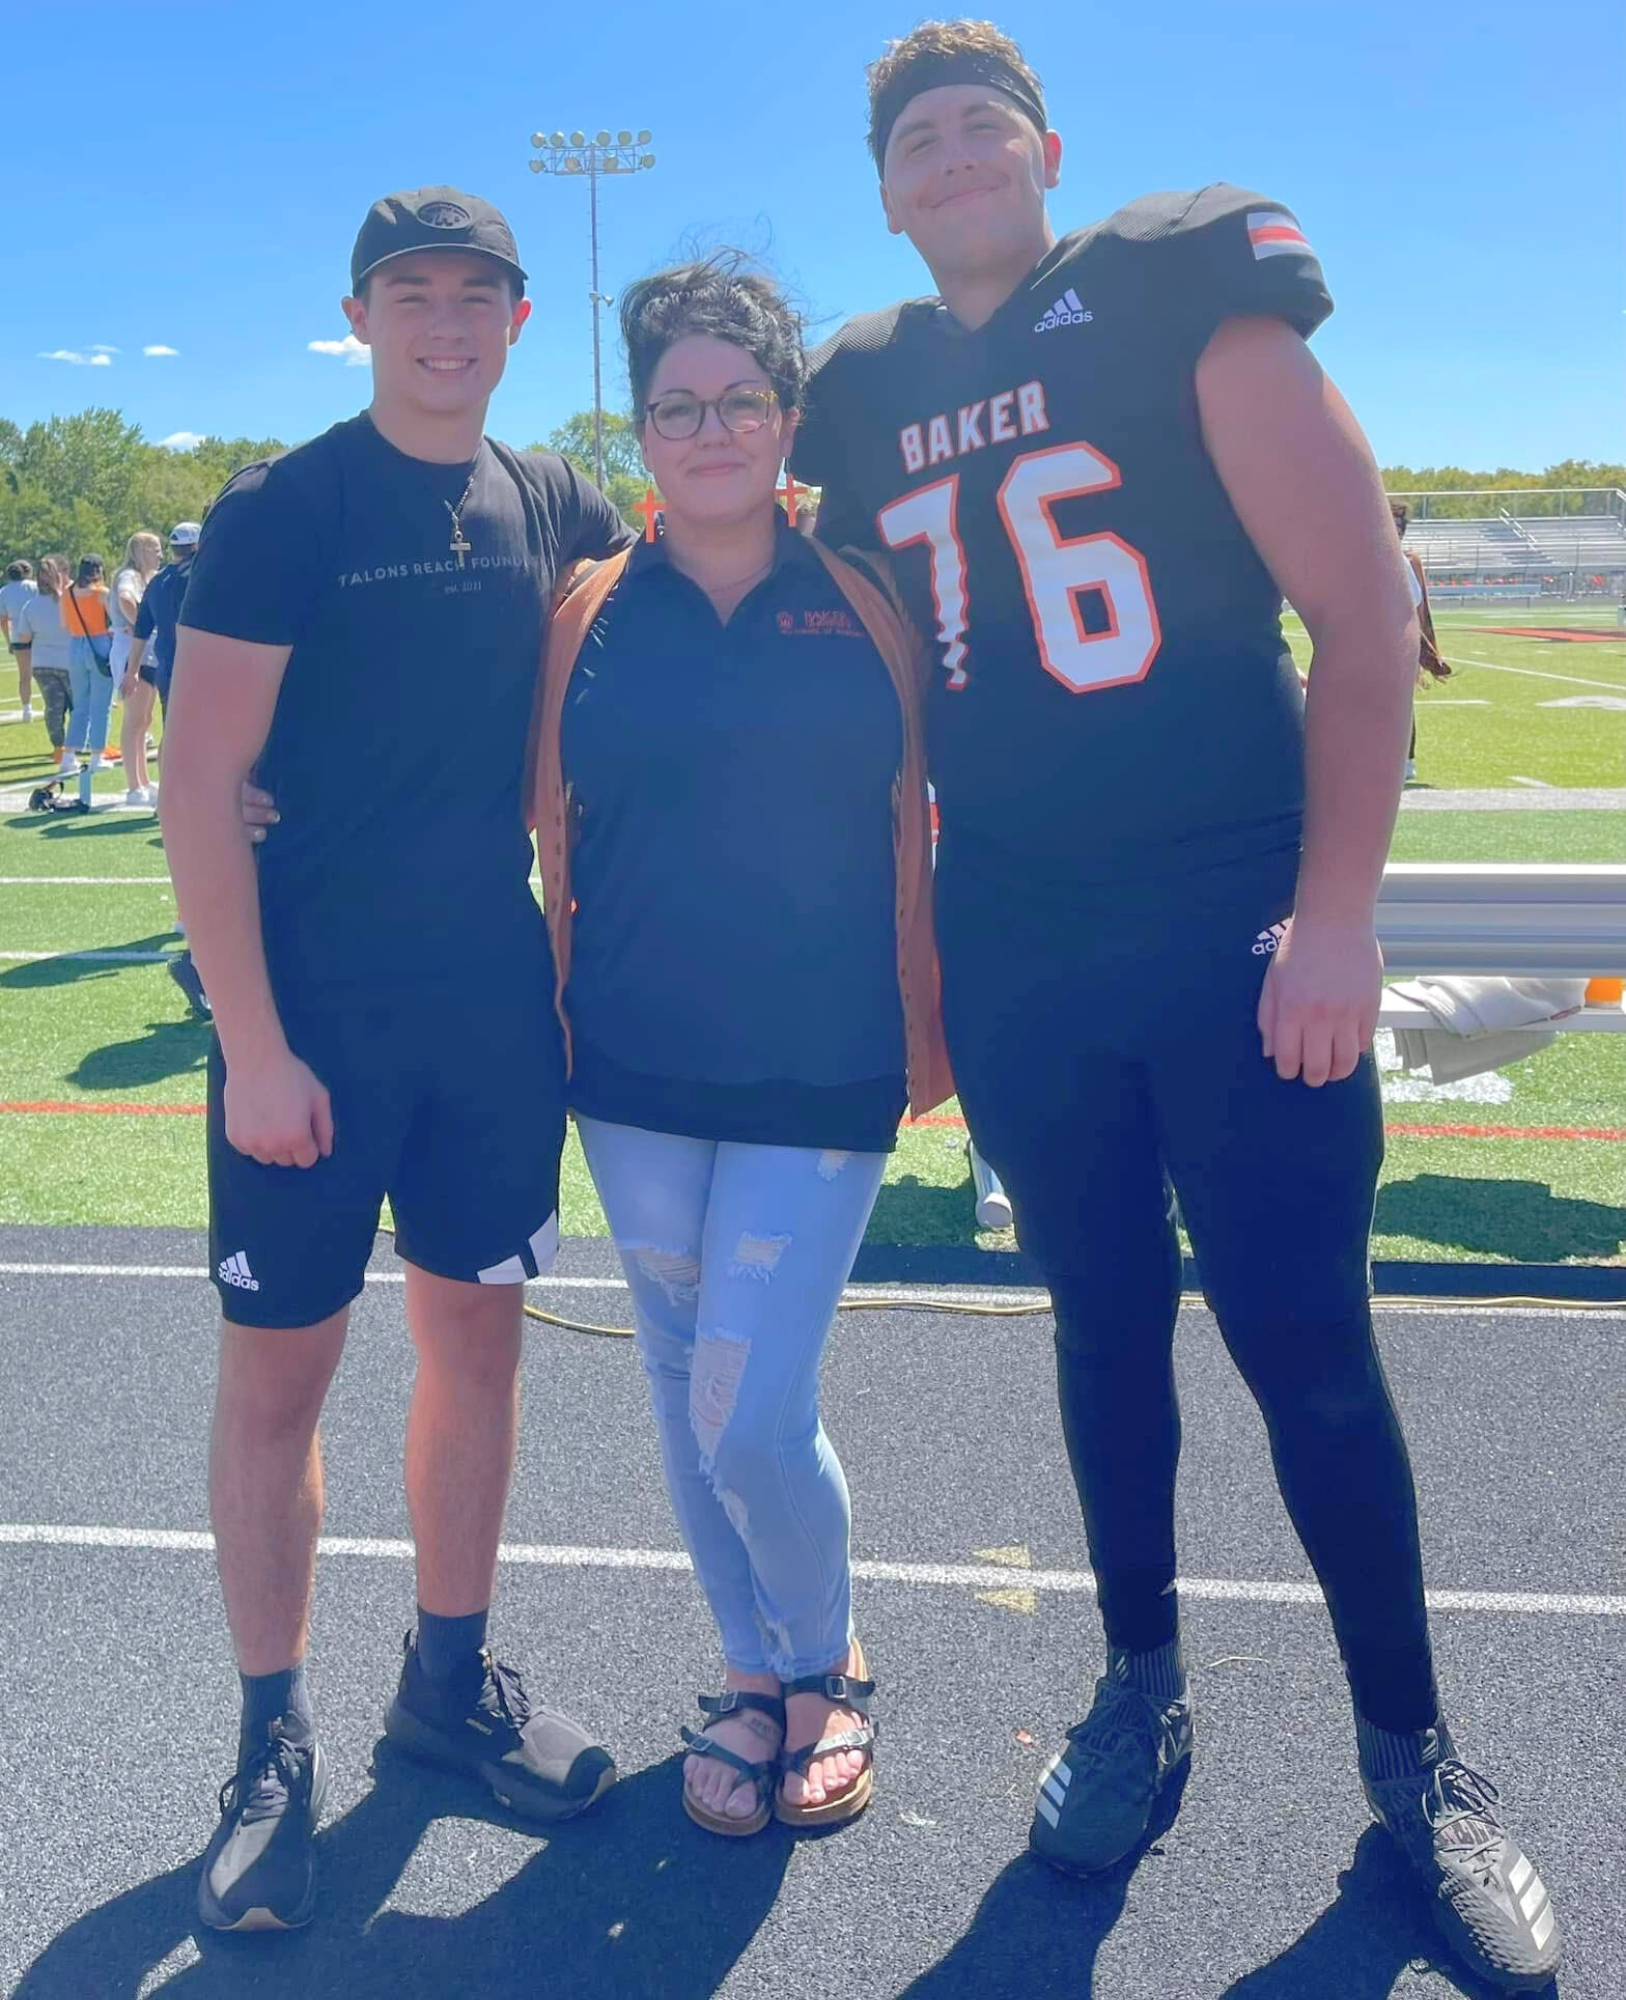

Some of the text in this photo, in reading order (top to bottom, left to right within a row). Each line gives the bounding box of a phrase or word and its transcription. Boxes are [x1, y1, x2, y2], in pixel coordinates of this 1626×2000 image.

[1034, 309, 1094, 333] adidas
[901, 380, 1050, 474] BAKER
[338, 563, 408, 588] TALONS
[877, 440, 1162, 694] 76
[218, 1266, 260, 1292] adidas
